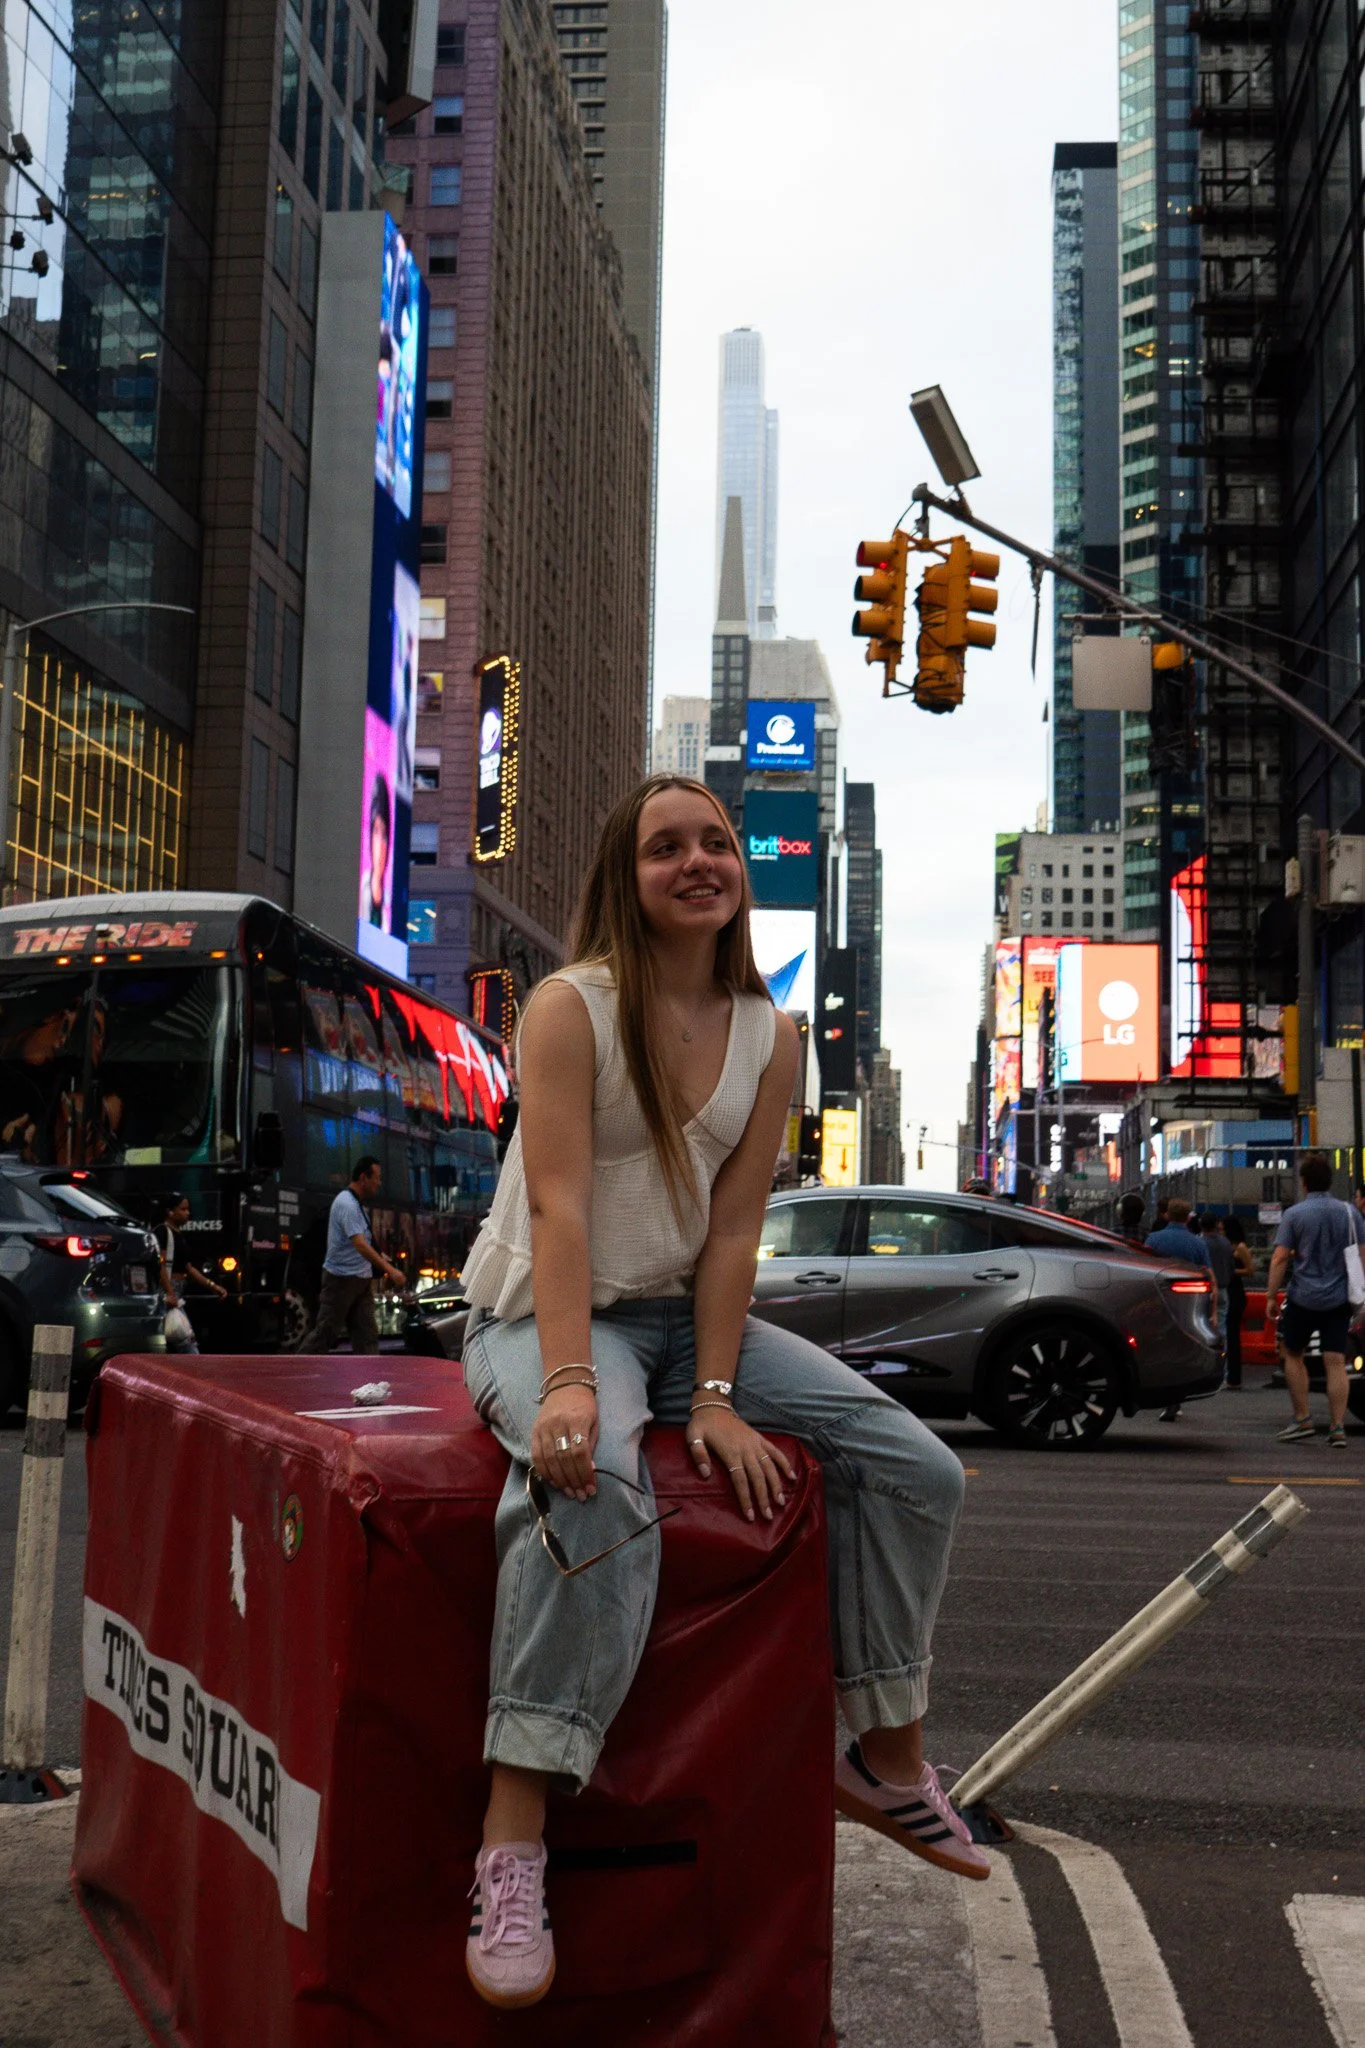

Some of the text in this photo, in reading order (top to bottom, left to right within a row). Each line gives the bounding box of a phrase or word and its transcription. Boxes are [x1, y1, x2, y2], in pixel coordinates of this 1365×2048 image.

[749, 835, 811, 855] britbox
[13, 921, 197, 955] THE RIDE
[1104, 1023, 1135, 1046] LG
[182, 1683, 281, 1862] SQUAR
